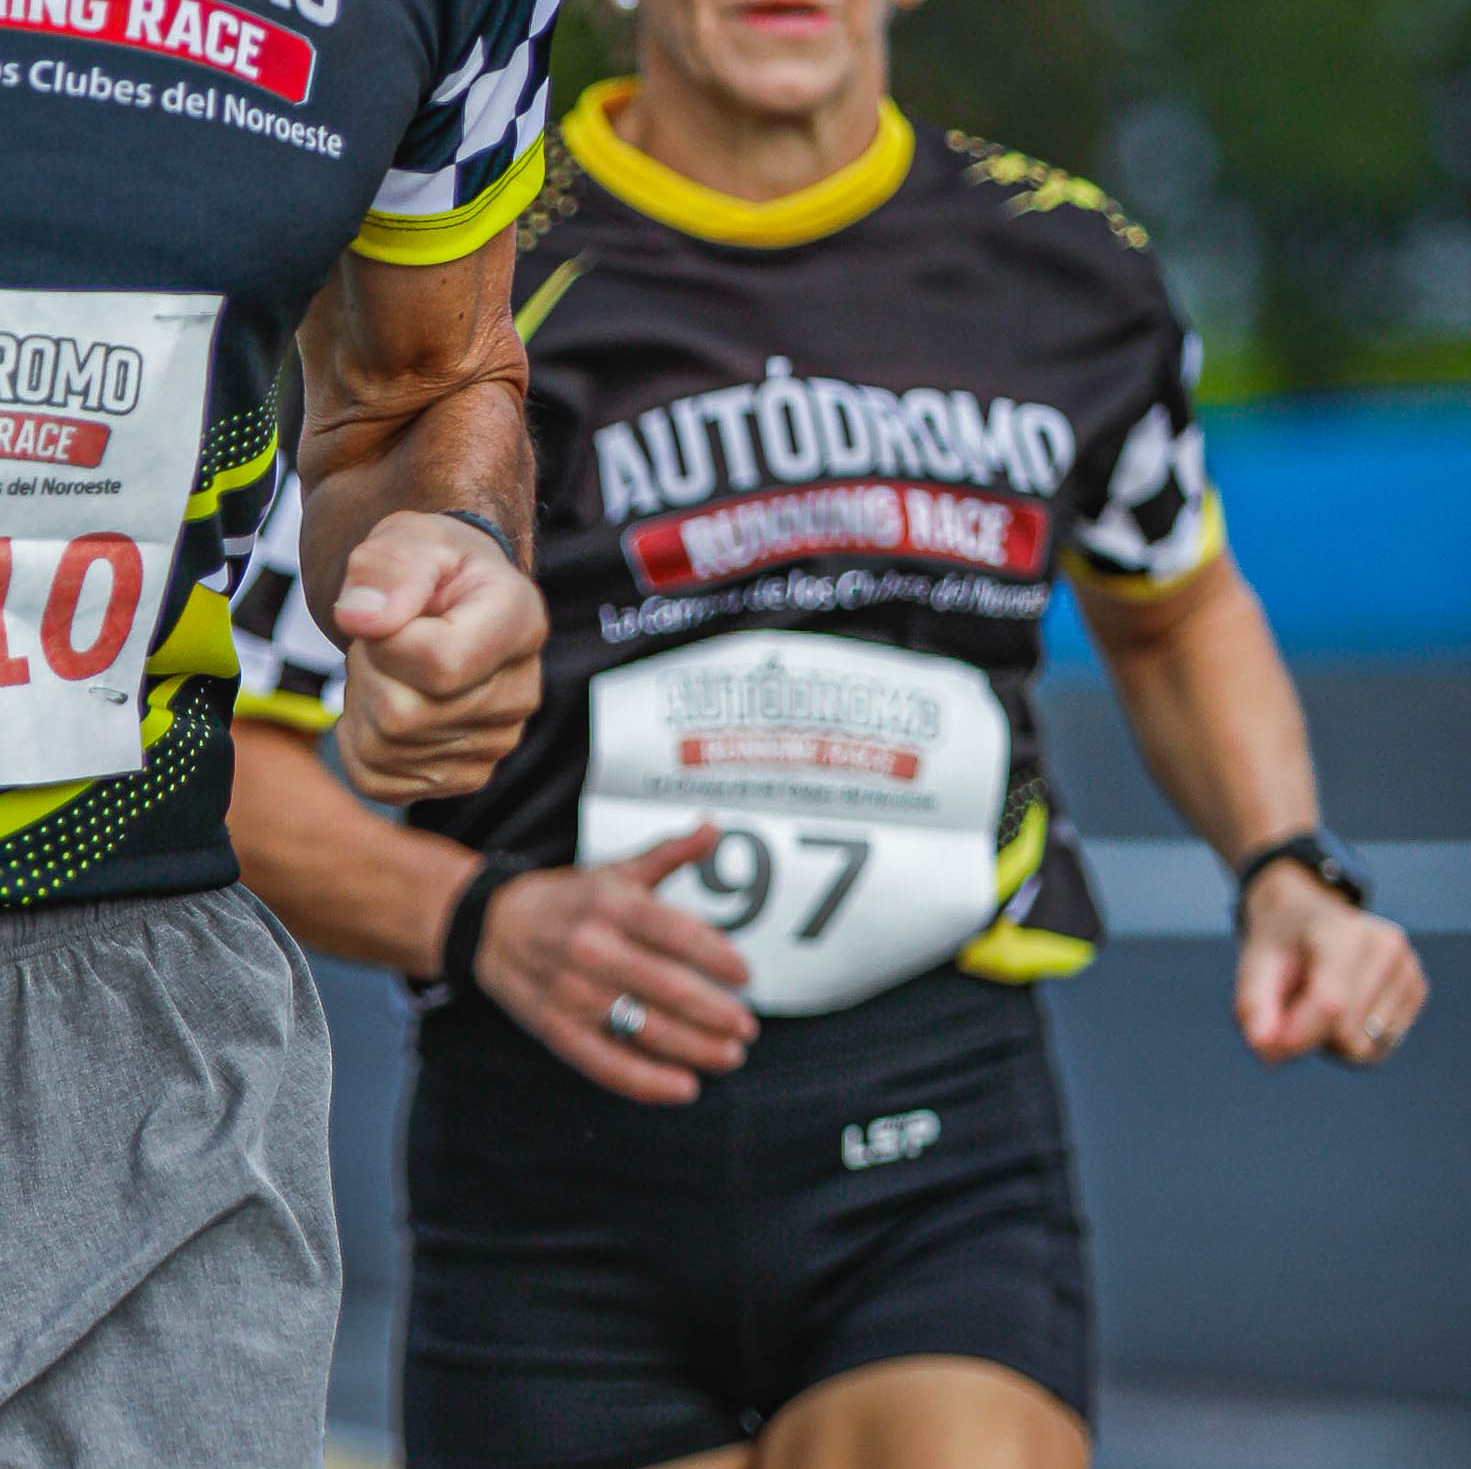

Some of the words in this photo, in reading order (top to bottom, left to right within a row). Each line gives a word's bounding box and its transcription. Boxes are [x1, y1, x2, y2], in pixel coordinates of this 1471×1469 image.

[28, 60, 153, 108] Clubes
[161, 82, 217, 120] del
[223, 94, 343, 159] Noroeste
[7, 476, 36, 496] del
[40, 478, 122, 496] Noroeste
[593, 355, 1076, 526] AUTÓDROMO
[697, 828, 871, 942] 97
